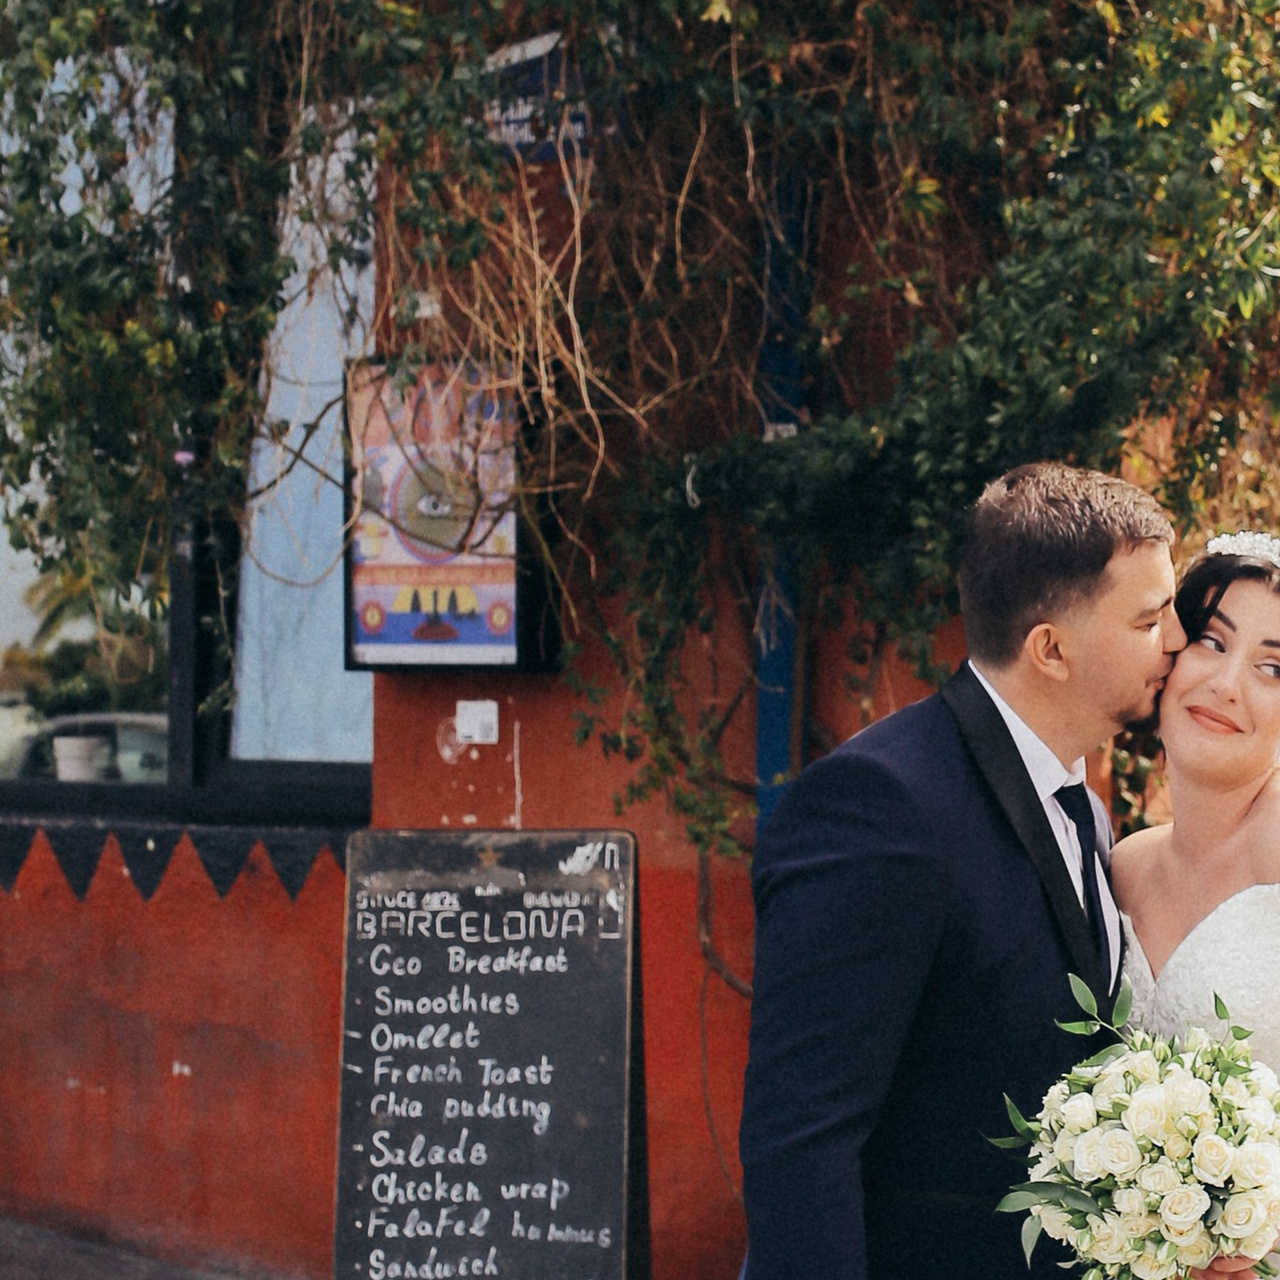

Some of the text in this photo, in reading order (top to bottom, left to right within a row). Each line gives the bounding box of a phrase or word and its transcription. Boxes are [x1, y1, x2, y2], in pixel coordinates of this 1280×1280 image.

[356, 908, 585, 943] BARCELONA
[447, 945, 569, 976] Breakfast
[375, 983, 520, 1016] Smoothies
[374, 1054, 554, 1086] French Toast
[370, 1090, 551, 1136] Chia pudding
[370, 1127, 488, 1167] Salads
[371, 1171, 570, 1210] Chicken wrap
[369, 1246, 498, 1280] Sandwich
